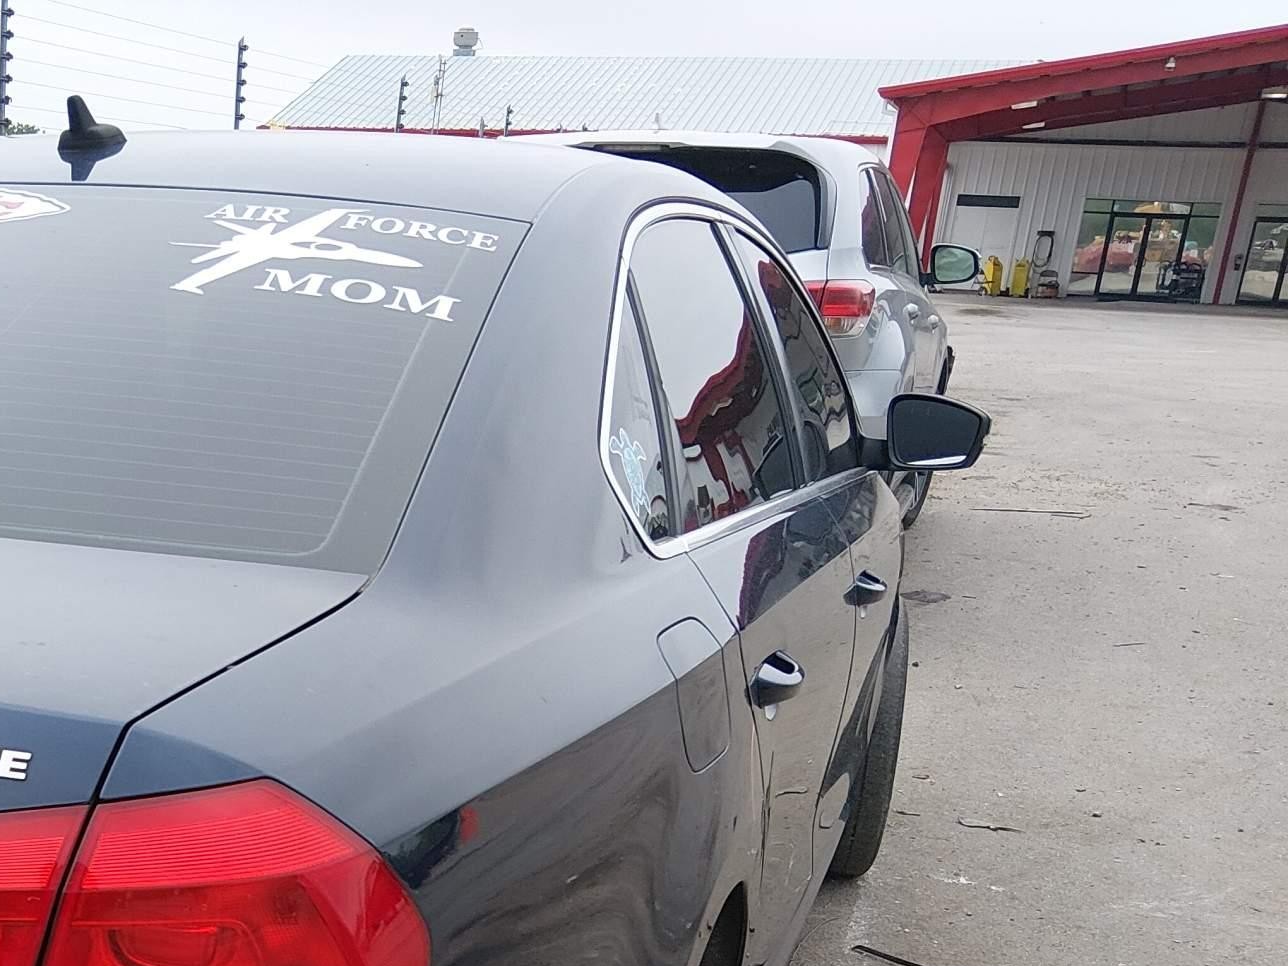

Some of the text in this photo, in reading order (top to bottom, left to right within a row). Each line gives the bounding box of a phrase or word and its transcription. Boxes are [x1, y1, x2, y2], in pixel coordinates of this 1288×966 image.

[203, 203, 500, 252] AIR FORCE
[254, 268, 462, 322] MOM
